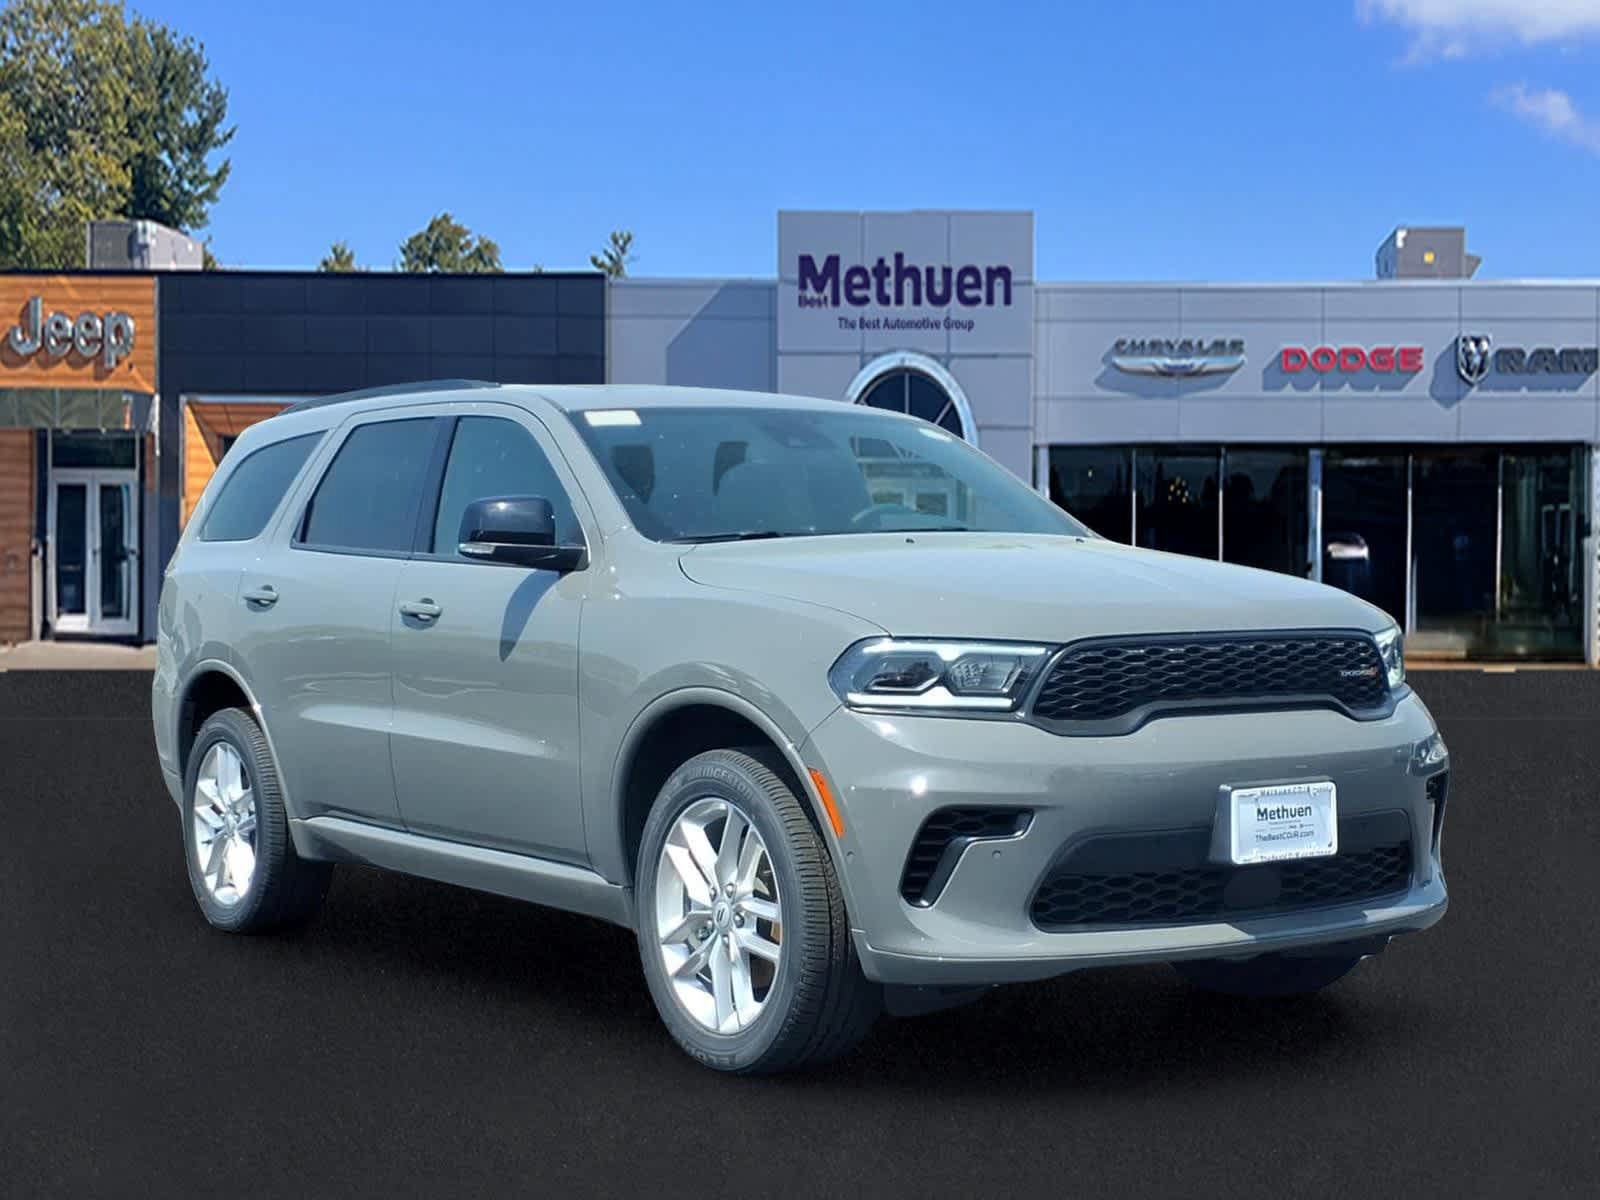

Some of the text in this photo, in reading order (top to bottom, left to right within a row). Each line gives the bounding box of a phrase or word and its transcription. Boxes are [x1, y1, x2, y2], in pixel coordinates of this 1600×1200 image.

[798, 252, 1012, 307] Methuen
[9, 296, 135, 368] Jeep
[838, 317, 974, 332] The Best Automotive Group
[1114, 337, 1244, 356] CHRYSLER
[1281, 345, 1424, 373] DODGE
[1495, 347, 1598, 374] RAM
[1256, 805, 1312, 821] Methuen
